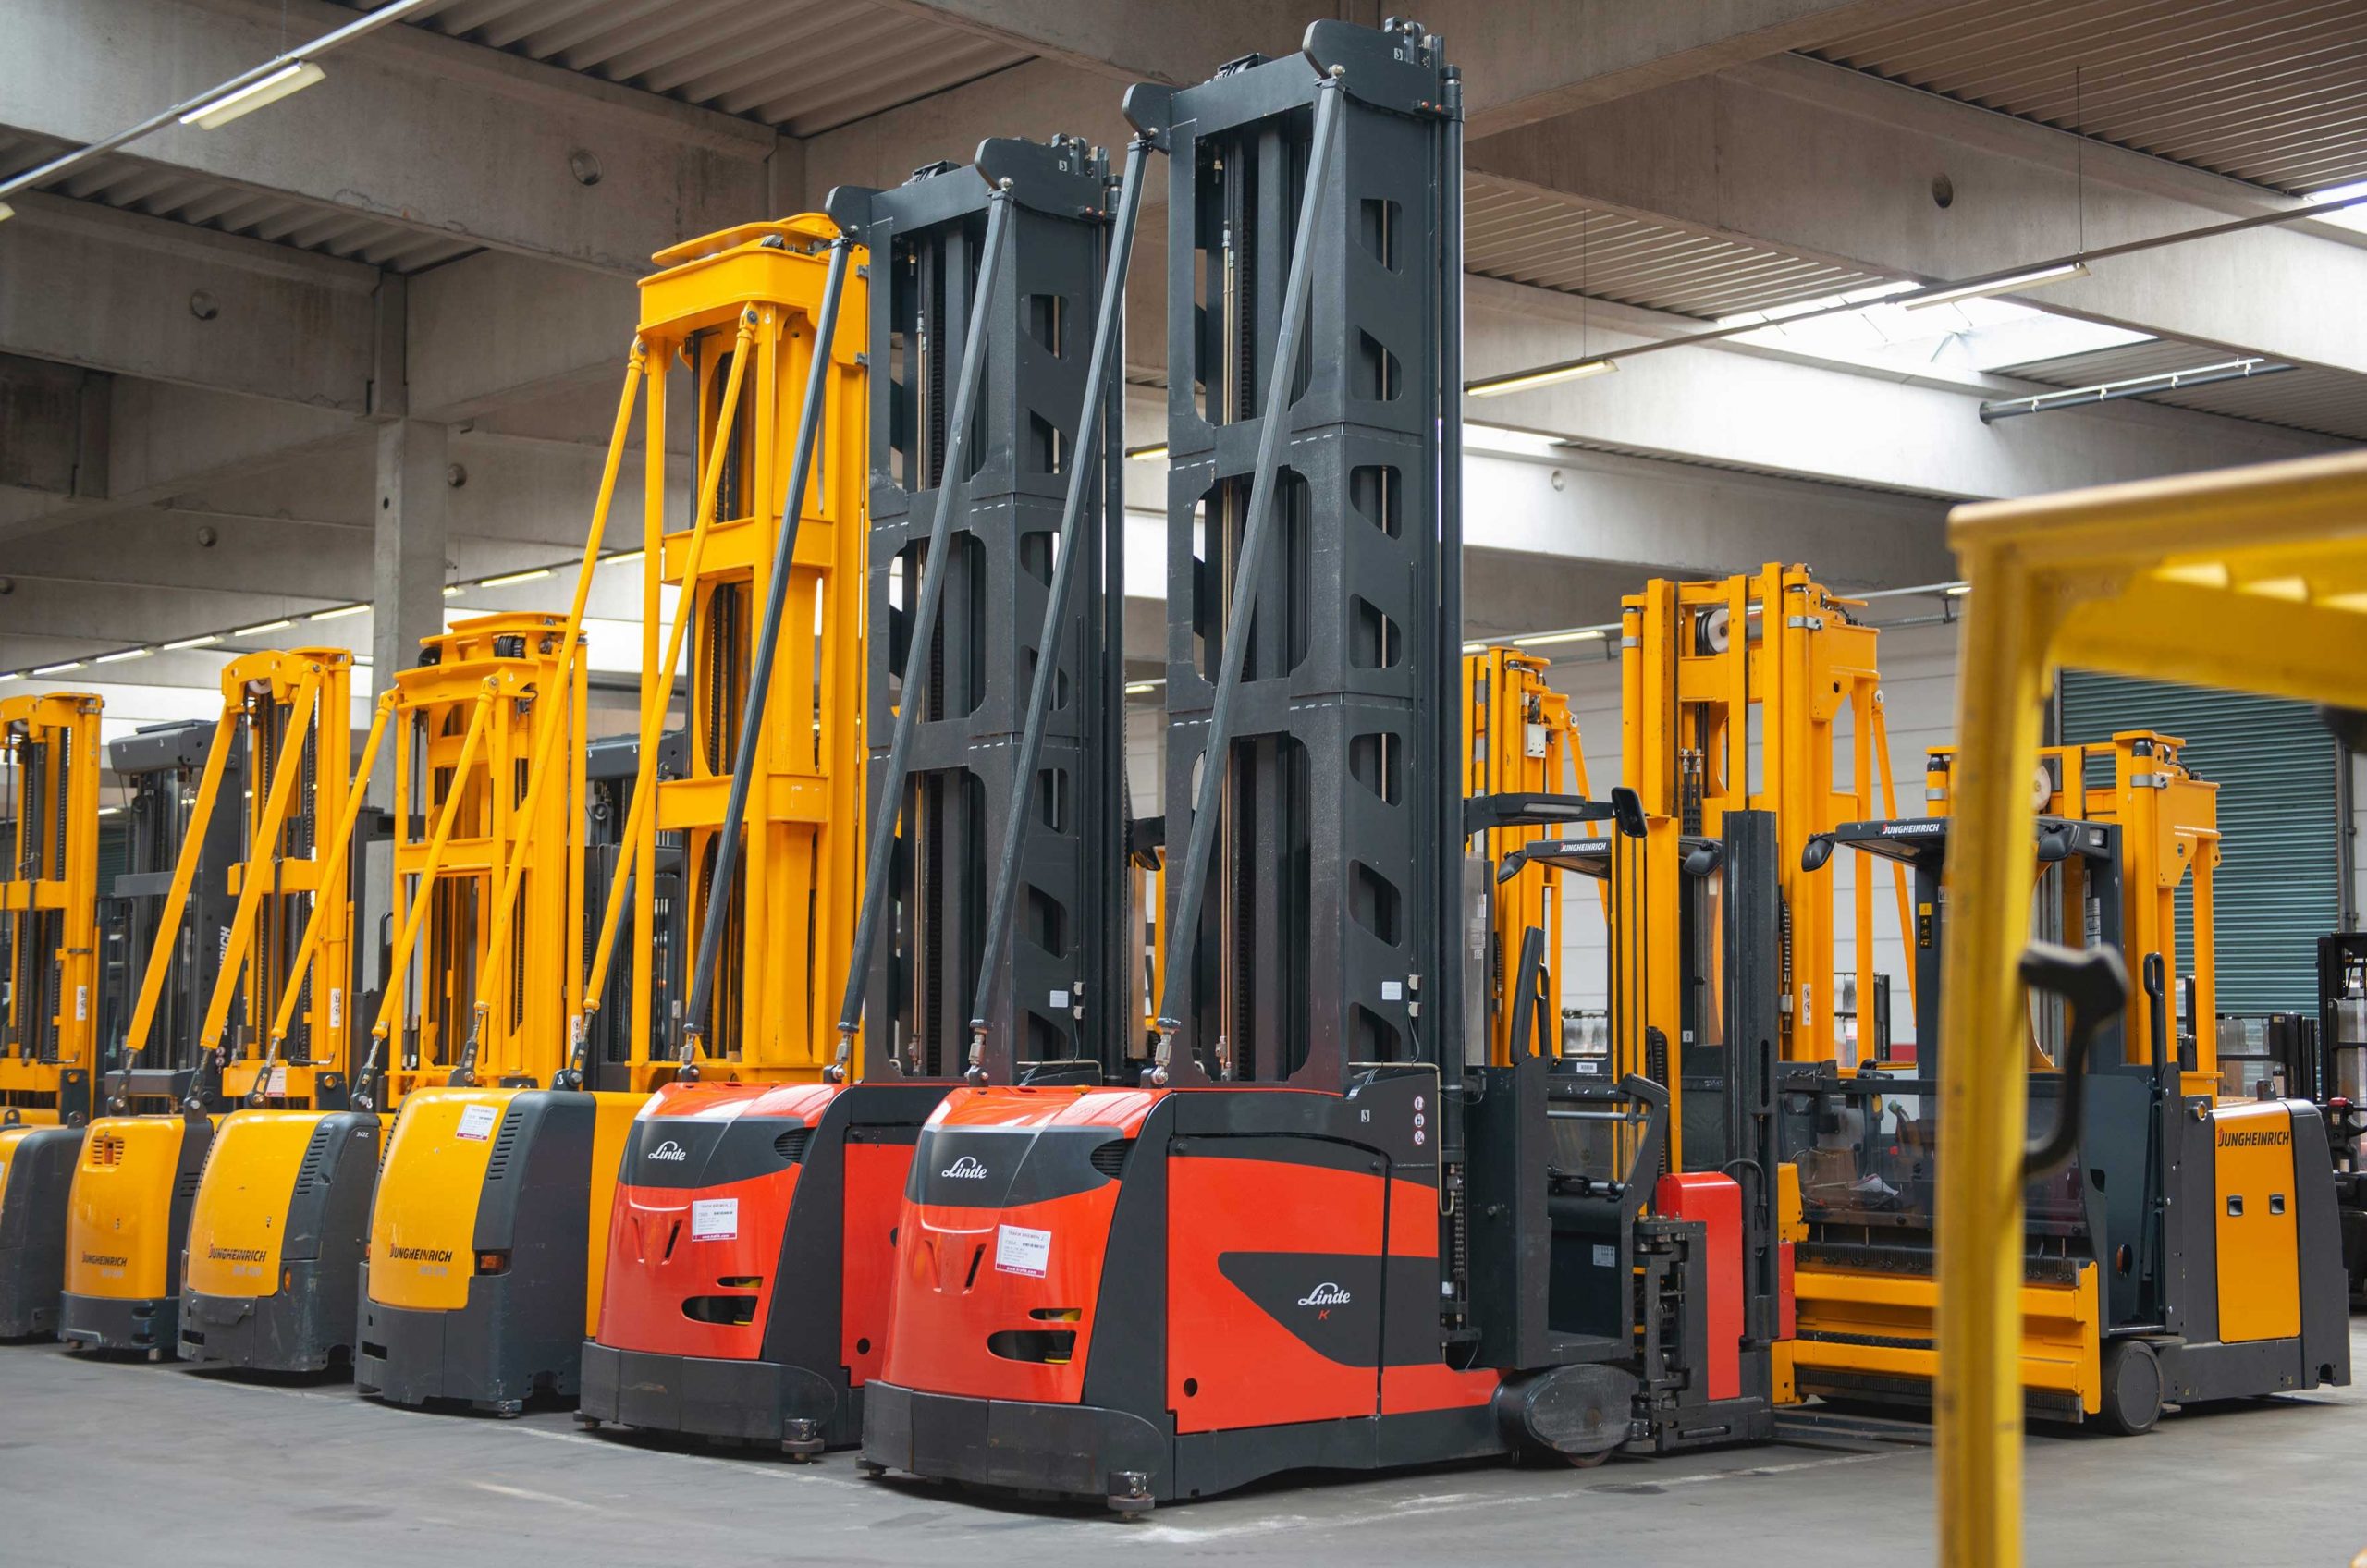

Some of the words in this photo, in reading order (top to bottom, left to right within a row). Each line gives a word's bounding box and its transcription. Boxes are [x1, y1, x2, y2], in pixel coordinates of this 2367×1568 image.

[1881, 822, 1940, 835] JUNGHEINRICH
[1560, 842, 1607, 852] JUNGHEINRICH
[2217, 1127, 2290, 1147] JUNGHEINRICH
[647, 1140, 686, 1161] Linde
[941, 1156, 987, 1179] Linde
[81, 1251, 128, 1267] JUNGHEINRICH
[209, 1243, 267, 1263] JUNGHEINRICH
[389, 1243, 453, 1262] JUNGHEINRICH
[1297, 1282, 1351, 1305] Linde
[1318, 1309, 1331, 1321] K
